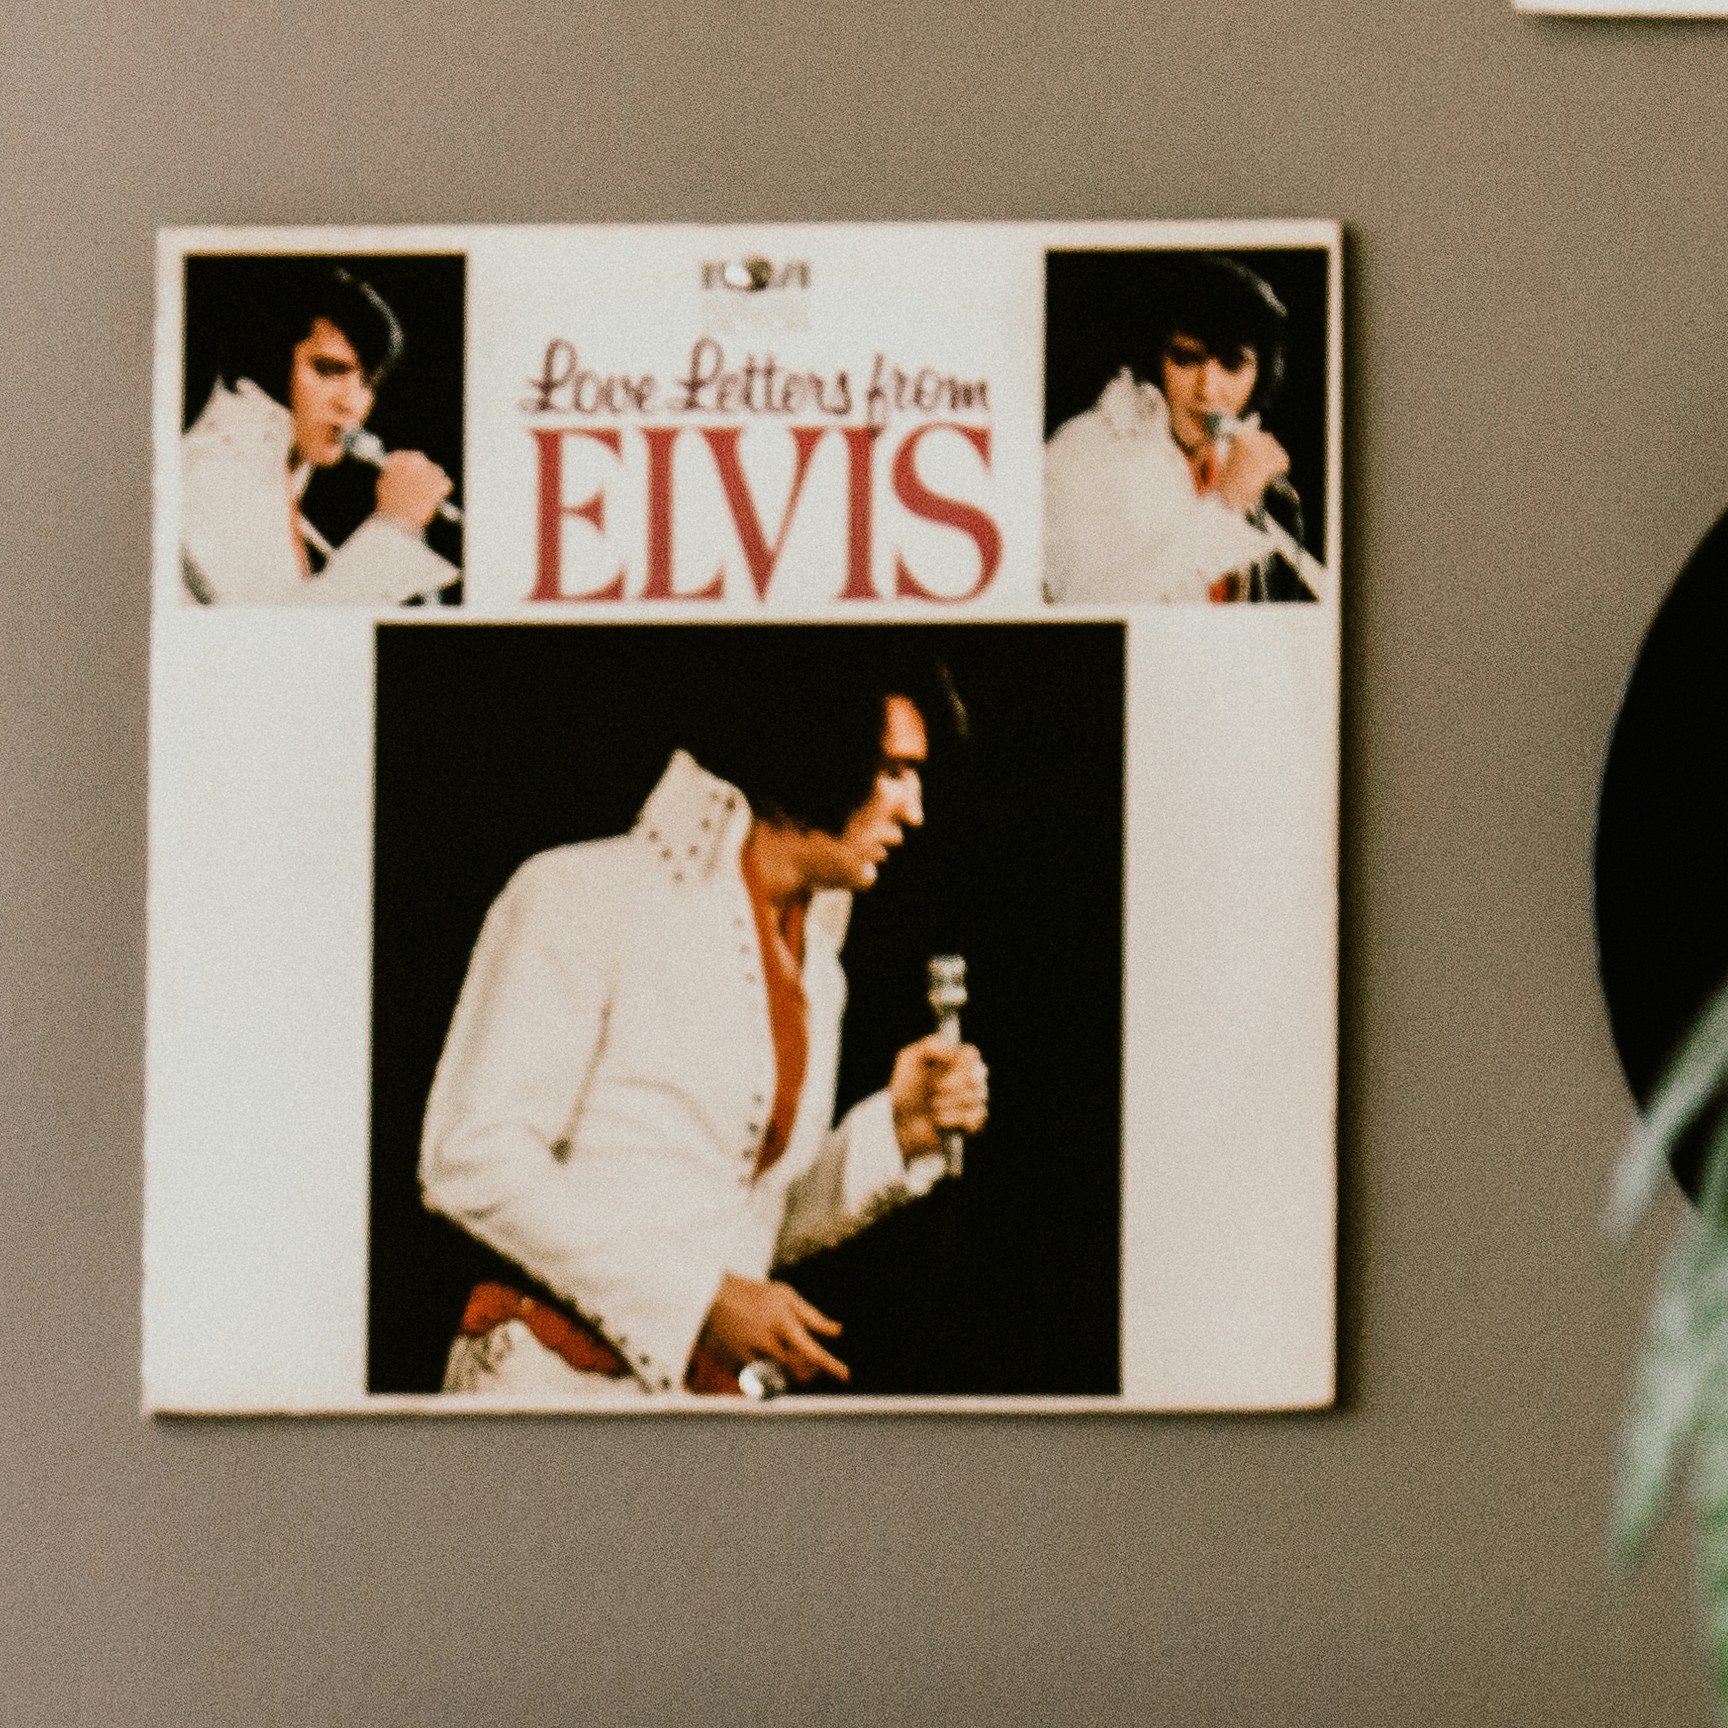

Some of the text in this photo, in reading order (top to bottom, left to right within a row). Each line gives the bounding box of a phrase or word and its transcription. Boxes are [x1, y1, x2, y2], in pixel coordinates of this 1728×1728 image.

[520, 336, 991, 438] Love Letters from
[524, 420, 1005, 603] ELVIS
